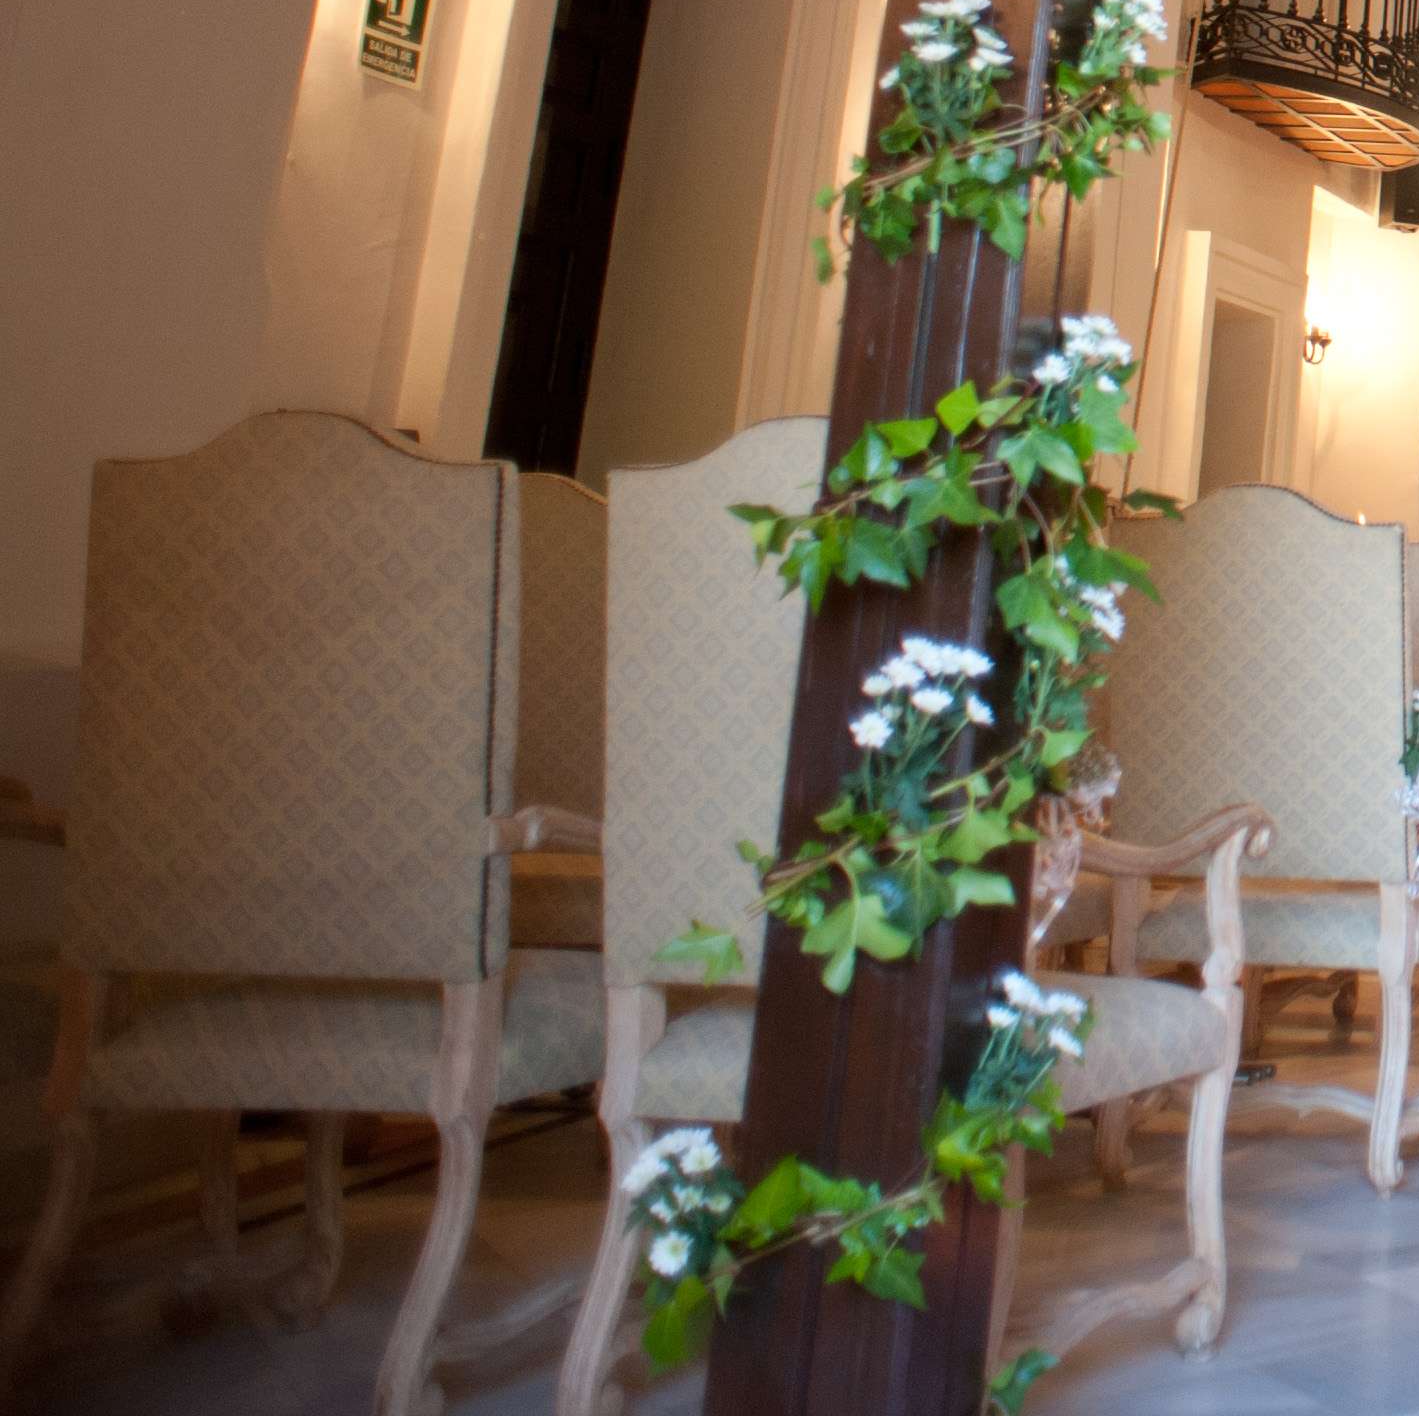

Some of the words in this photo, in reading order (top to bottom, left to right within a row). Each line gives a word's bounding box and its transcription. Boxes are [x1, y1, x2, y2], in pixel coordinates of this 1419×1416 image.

[368, 39, 398, 58] SALIDA
[399, 48, 412, 63] DE
[362, 53, 416, 81] EMERGENCIA
